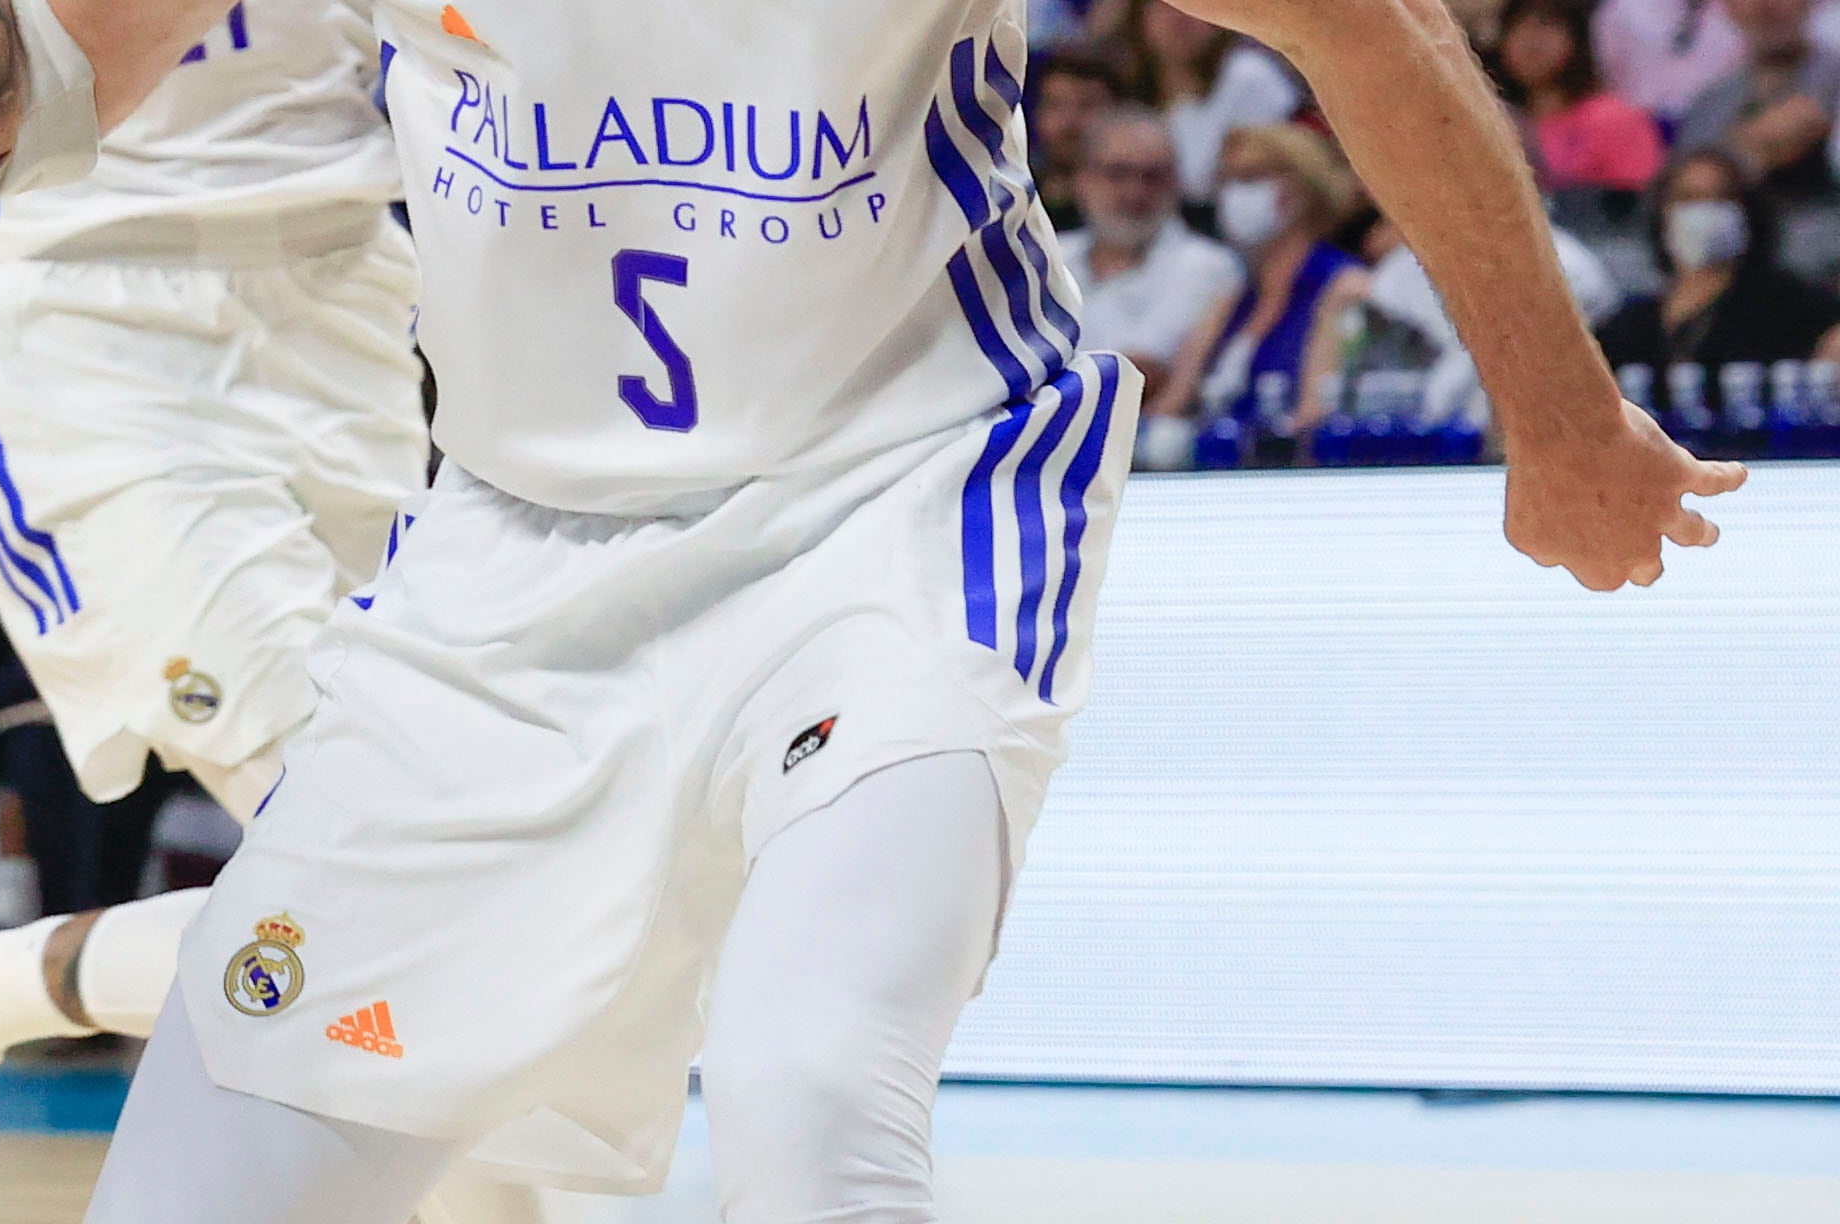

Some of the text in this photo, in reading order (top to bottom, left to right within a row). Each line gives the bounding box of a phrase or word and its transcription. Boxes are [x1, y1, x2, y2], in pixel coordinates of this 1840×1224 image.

[453, 68, 871, 181] PALLADIUM
[432, 166, 887, 244] HOTEL GROUP
[611, 248, 699, 433] 5
[325, 1024, 404, 1059] adidas
